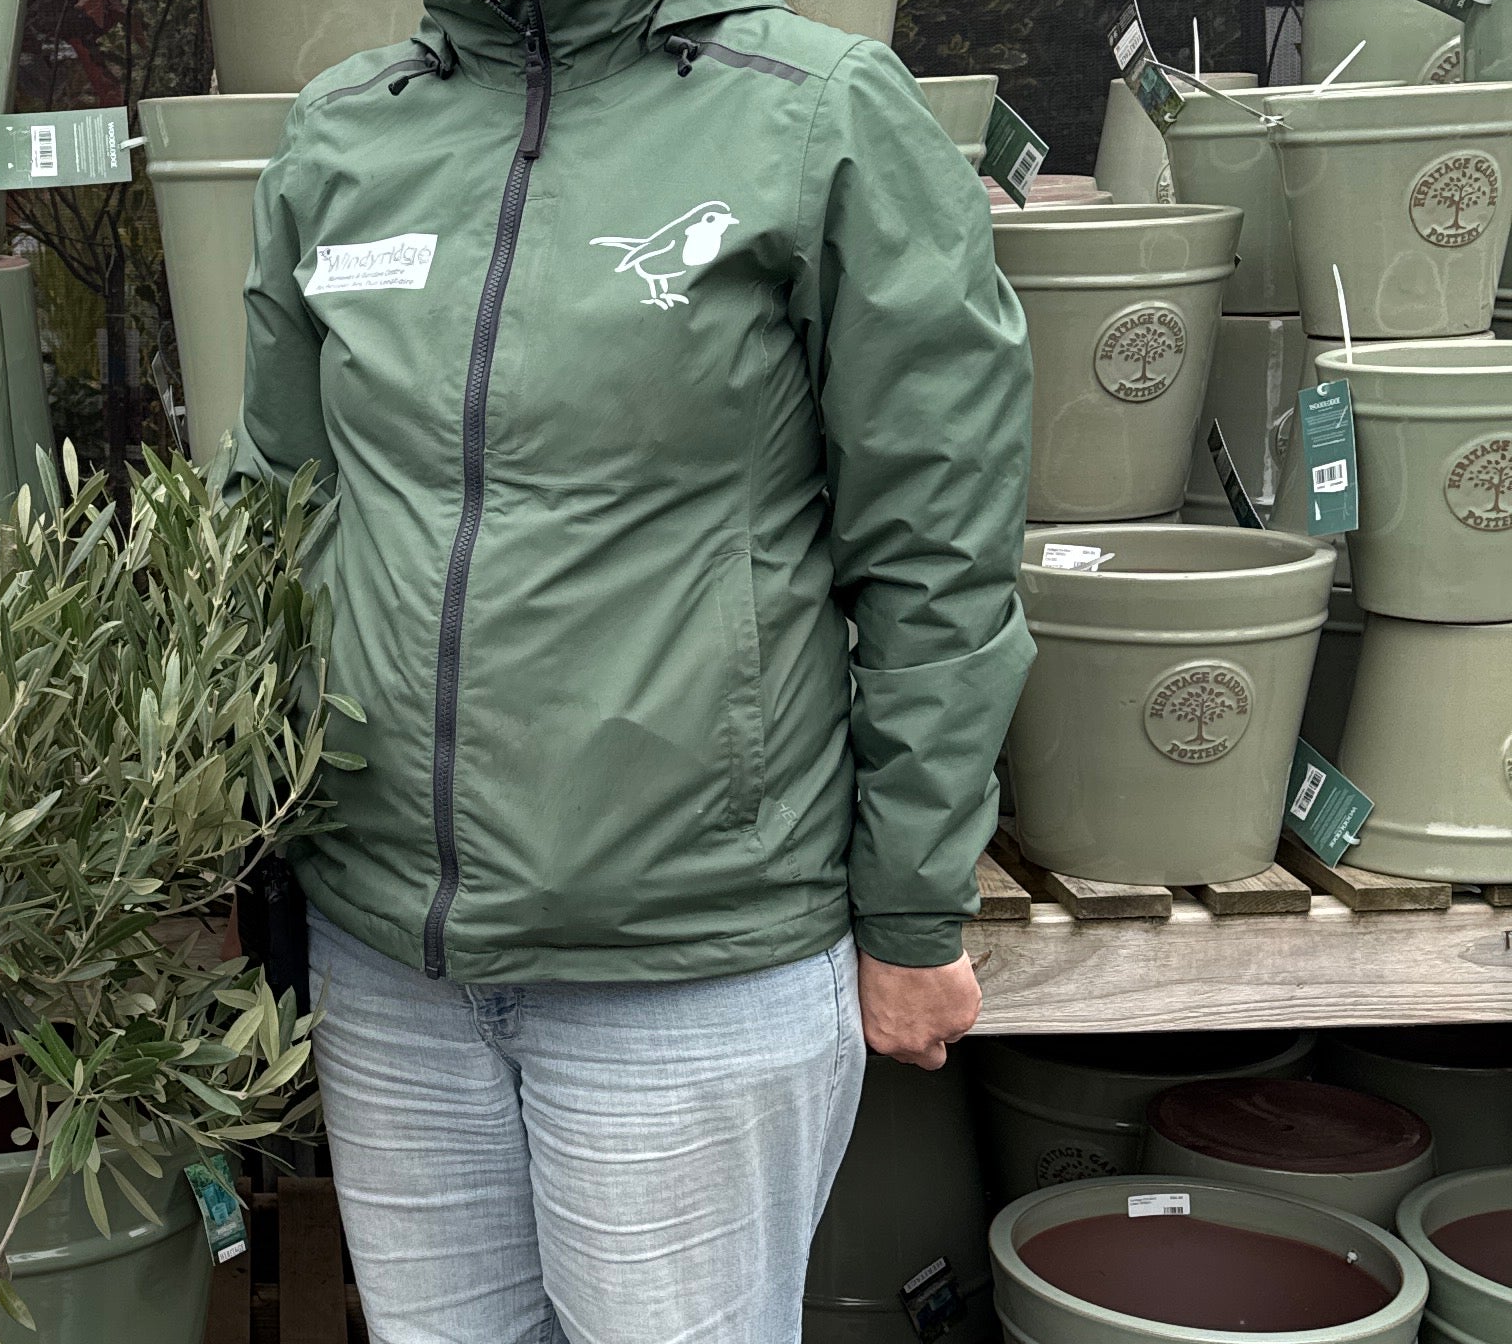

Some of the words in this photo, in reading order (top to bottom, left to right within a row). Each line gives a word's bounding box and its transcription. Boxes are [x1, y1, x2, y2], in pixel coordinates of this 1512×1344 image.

[1412, 157, 1472, 208] HERITAGE
[1426, 223, 1481, 245] POTTERY
[1100, 312, 1155, 361] HERITAGE
[1157, 313, 1185, 355] GARDEN
[1114, 376, 1167, 398] POTTERY
[1447, 439, 1510, 490] HERITAGE
[1149, 671, 1210, 719] HERITAGE
[1213, 672, 1249, 715] GARDEN
[1166, 738, 1229, 760] POTTERY
